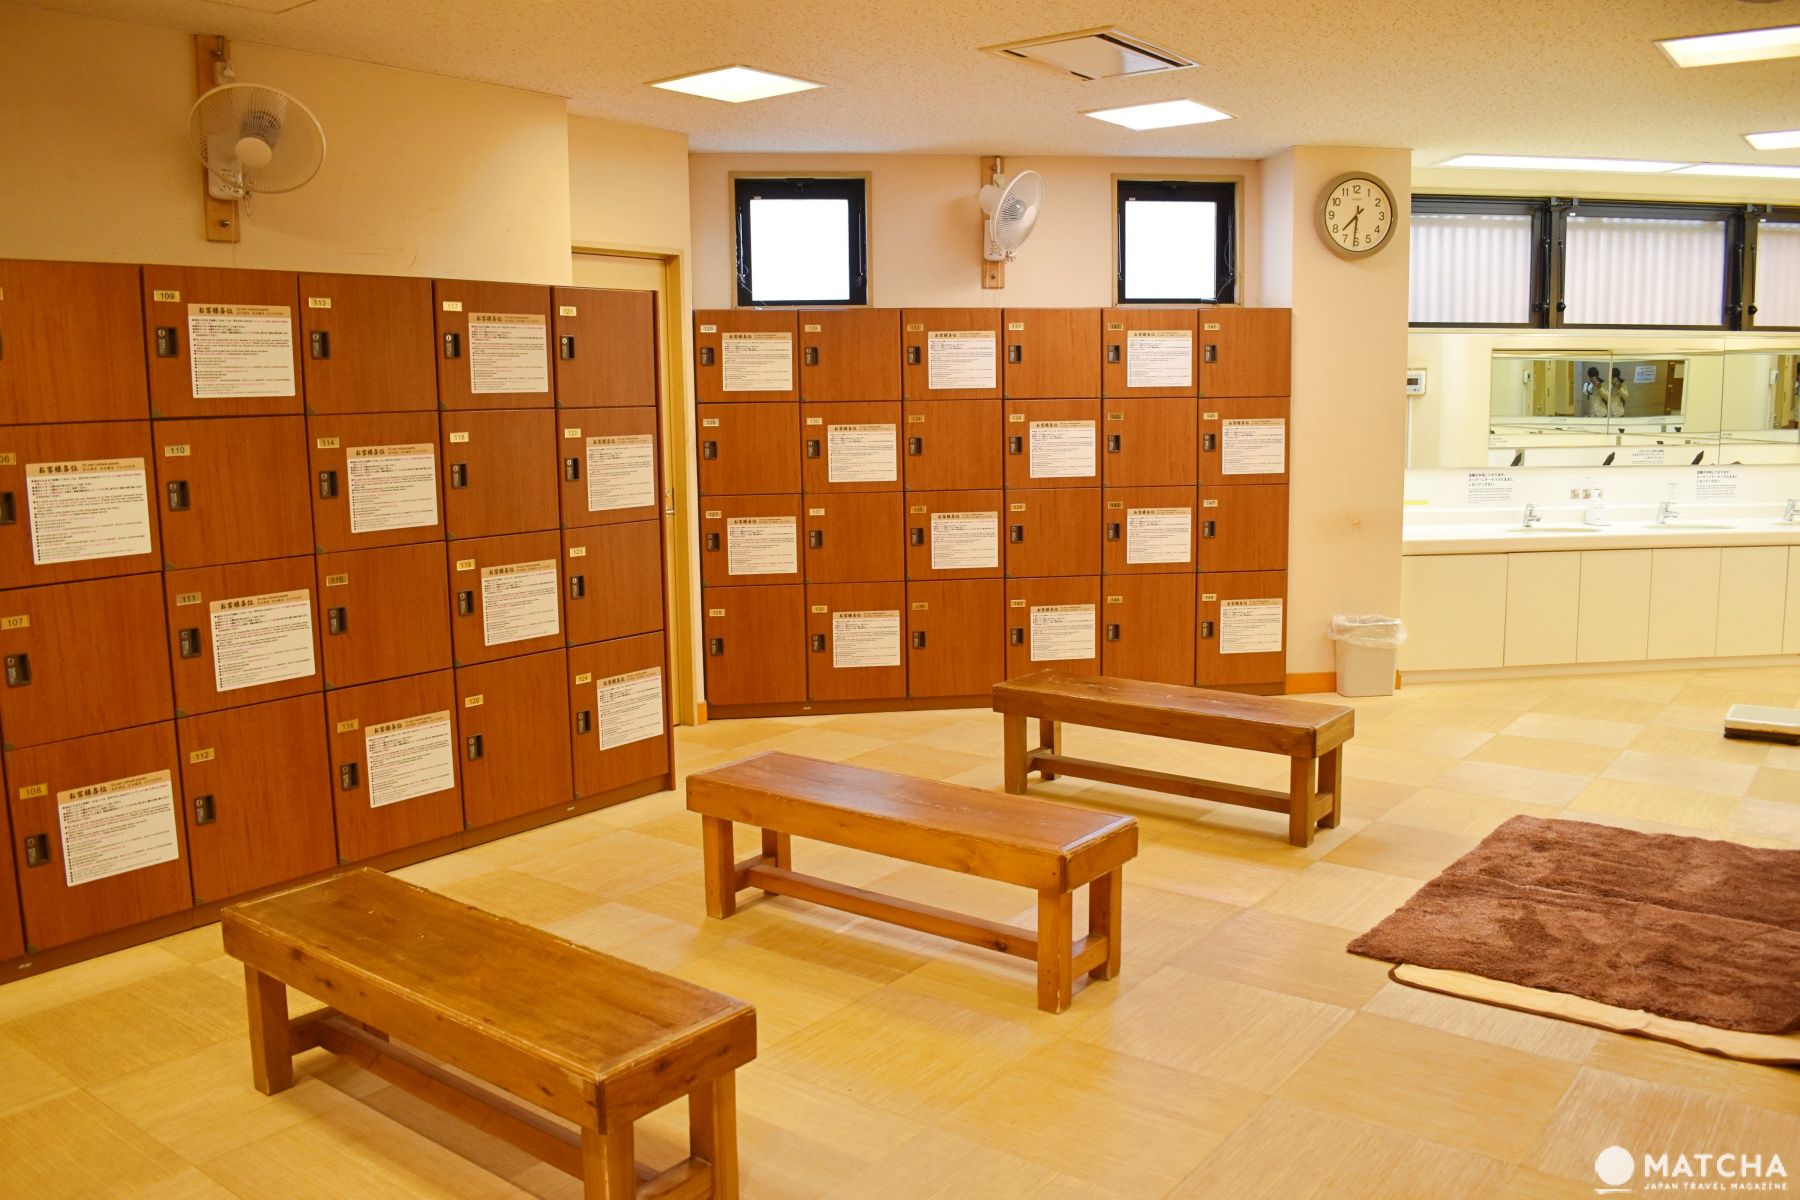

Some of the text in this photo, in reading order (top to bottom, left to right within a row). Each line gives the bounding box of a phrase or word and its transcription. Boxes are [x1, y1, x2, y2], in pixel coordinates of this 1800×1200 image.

[1342, 188, 1348, 196] 11
[1353, 185, 1361, 193] 12
[1368, 189, 1370, 197] 1
[1333, 198, 1341, 206] 10
[1375, 198, 1381, 207] 2
[1328, 211, 1335, 219] 9
[1379, 212, 1384, 220] 3
[1333, 224, 1339, 233] 8
[1374, 225, 1380, 233] 4
[1342, 234, 1348, 243] 7
[1354, 237, 1359, 246] 6
[1366, 235, 1371, 243] 5
[39, 465, 78, 473] お客様各位
[182, 595, 196, 603] 111
[220, 600, 253, 610] お客様各位
[8, 618, 24, 627] 107
[26, 788, 41, 796] 108
[69, 786, 107, 800] お客様各位
